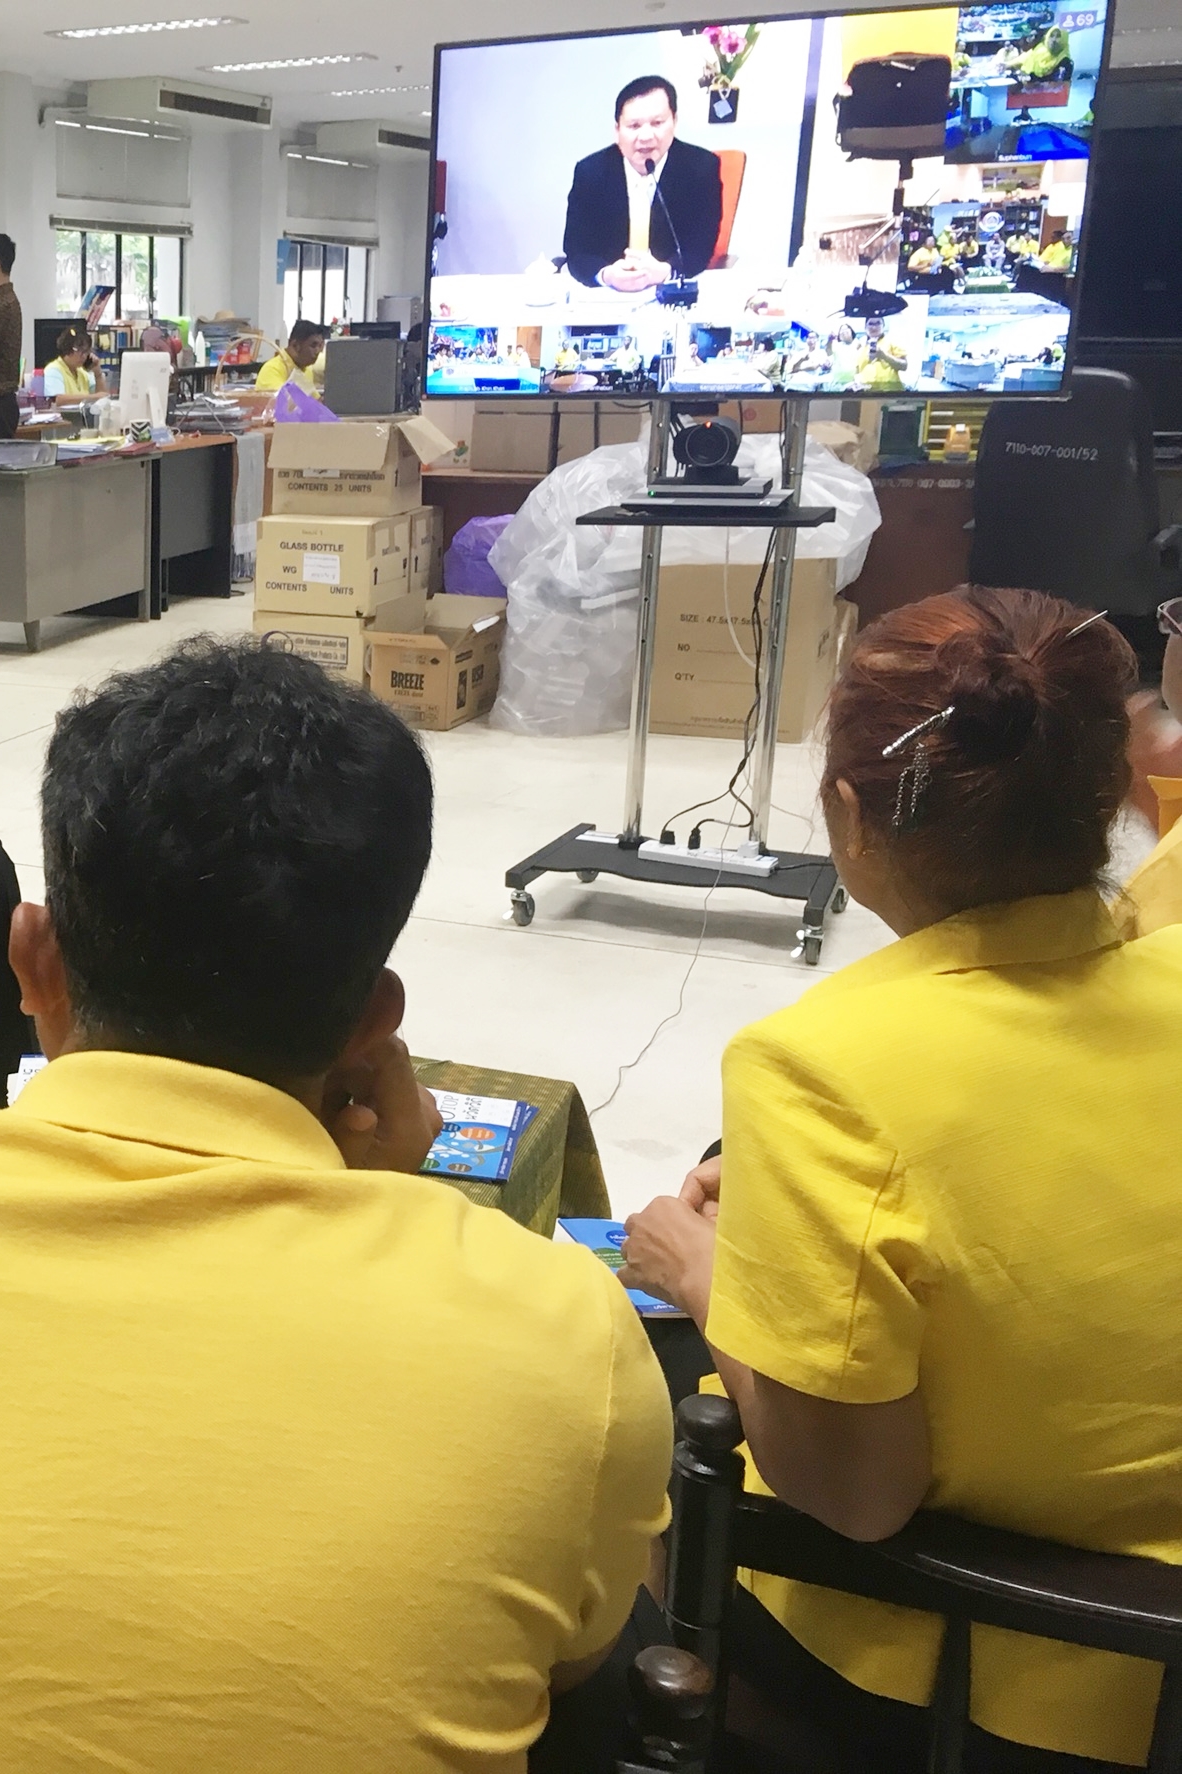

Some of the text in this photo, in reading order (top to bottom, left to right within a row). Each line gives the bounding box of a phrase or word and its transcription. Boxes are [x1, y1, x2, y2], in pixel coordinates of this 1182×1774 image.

[1076, 14, 1095, 26] 69
[287, 482, 372, 493] CONTENTS 25 UNITS
[279, 541, 344, 552] GLASS BOTTLE
[282, 565, 297, 574] WG
[265, 581, 354, 596] CONTENTS UNITS
[677, 643, 691, 652] NO
[390, 670, 425, 691] BREEZE
